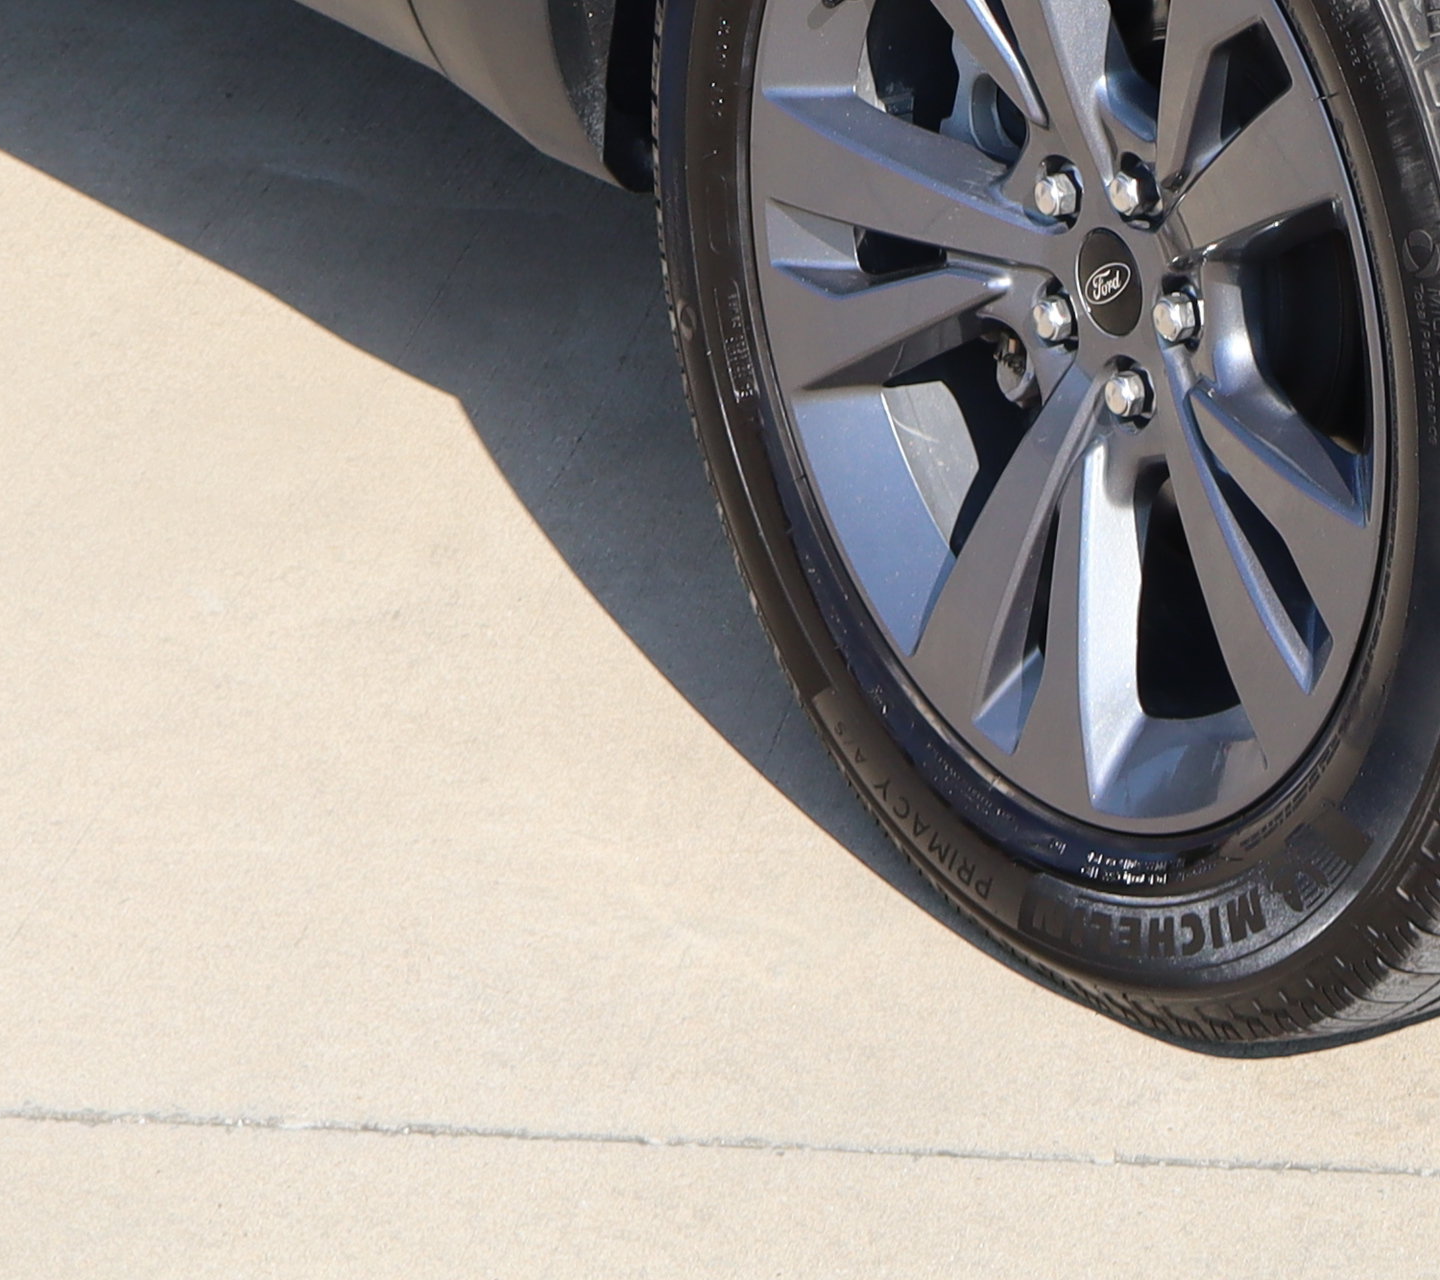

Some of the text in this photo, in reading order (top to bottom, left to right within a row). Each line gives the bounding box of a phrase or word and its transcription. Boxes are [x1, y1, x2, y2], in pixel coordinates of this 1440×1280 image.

[1092, 269, 1122, 301] Ford
[872, 778, 994, 901] PRIMACY
[1030, 890, 1268, 959] MICHELIN
